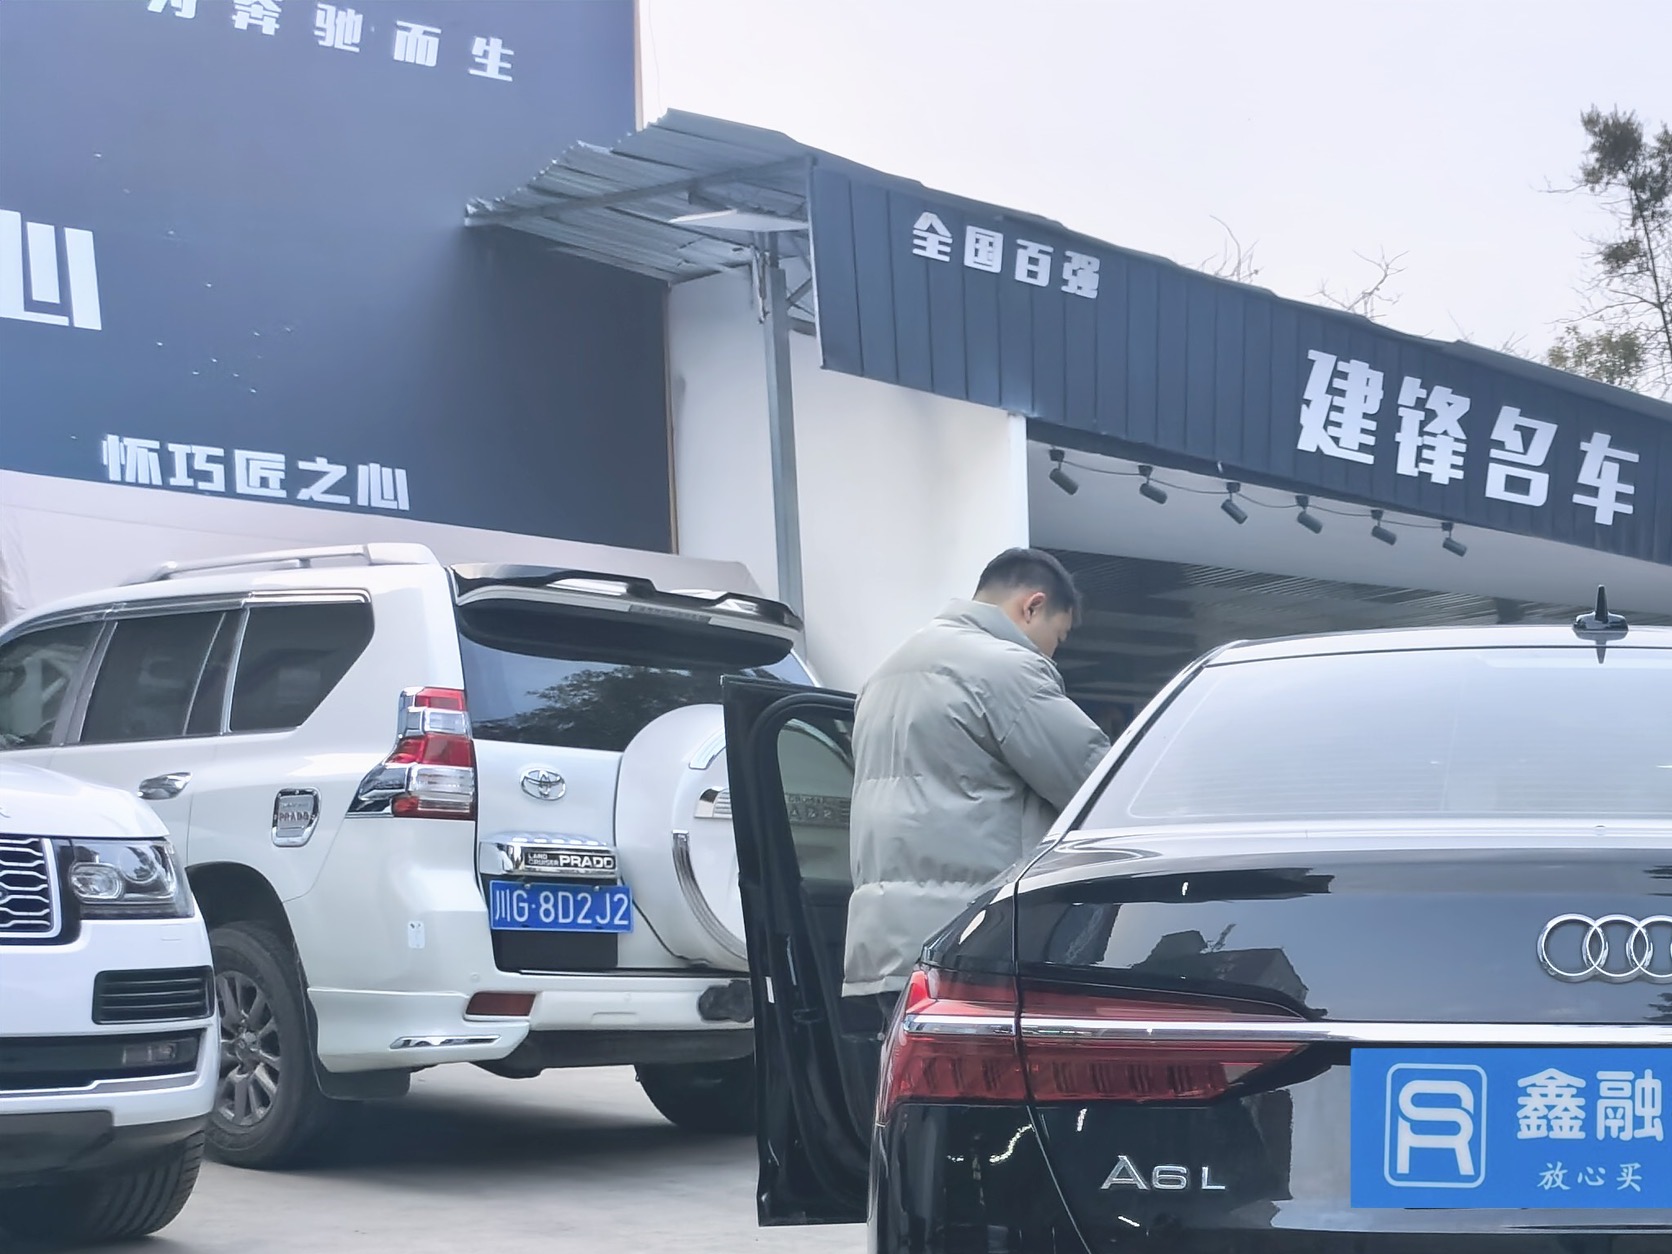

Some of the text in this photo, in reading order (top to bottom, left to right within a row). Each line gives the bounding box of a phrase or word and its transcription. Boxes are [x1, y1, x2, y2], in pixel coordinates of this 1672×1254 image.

[911, 210, 1102, 299] 全国百强
[102, 433, 410, 512] 怀巧匠之心
[1297, 349, 1640, 527] 建锋名车
[559, 855, 614, 868] PRADO
